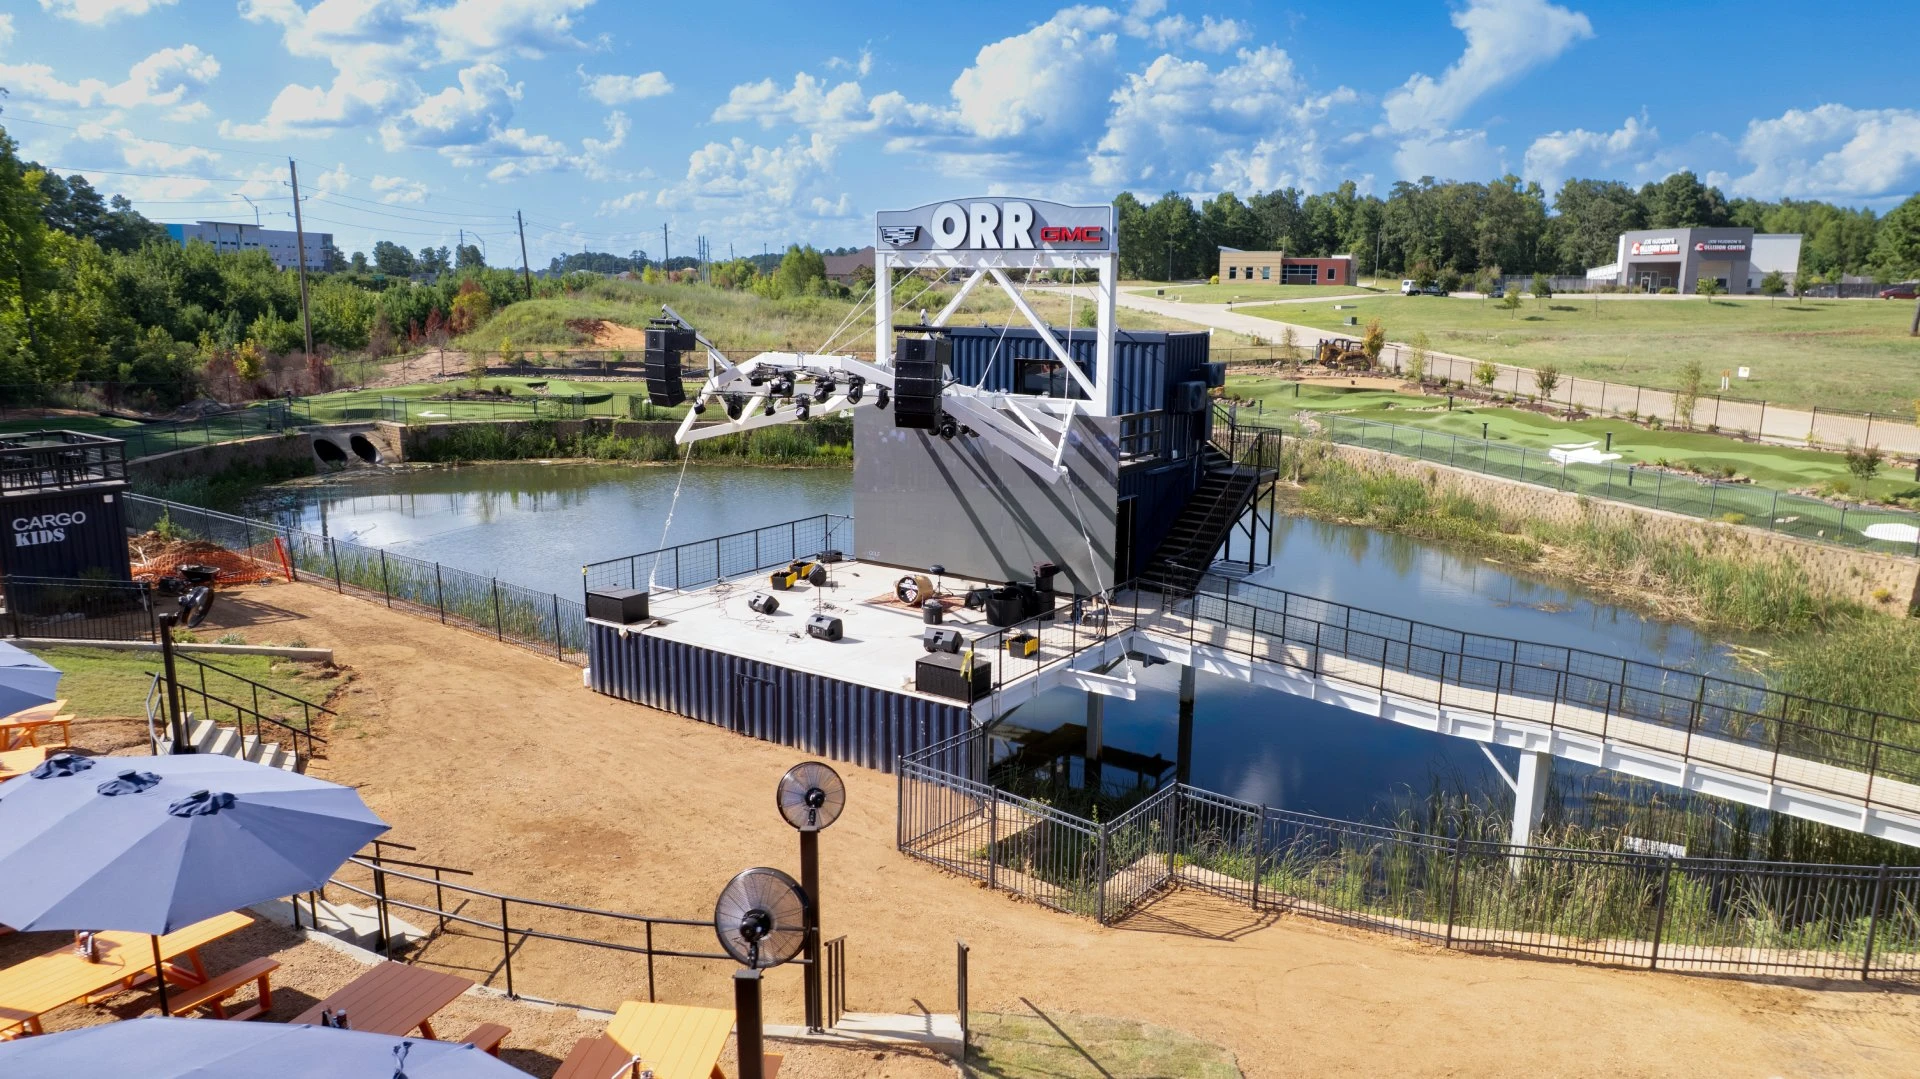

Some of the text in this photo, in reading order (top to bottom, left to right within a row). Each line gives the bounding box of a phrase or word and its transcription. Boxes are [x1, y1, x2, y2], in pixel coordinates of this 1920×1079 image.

[931, 202, 1036, 249] ORR
[1041, 226, 1102, 243] GMC
[12, 511, 86, 531] CARGO
[15, 528, 66, 546] KIDS
